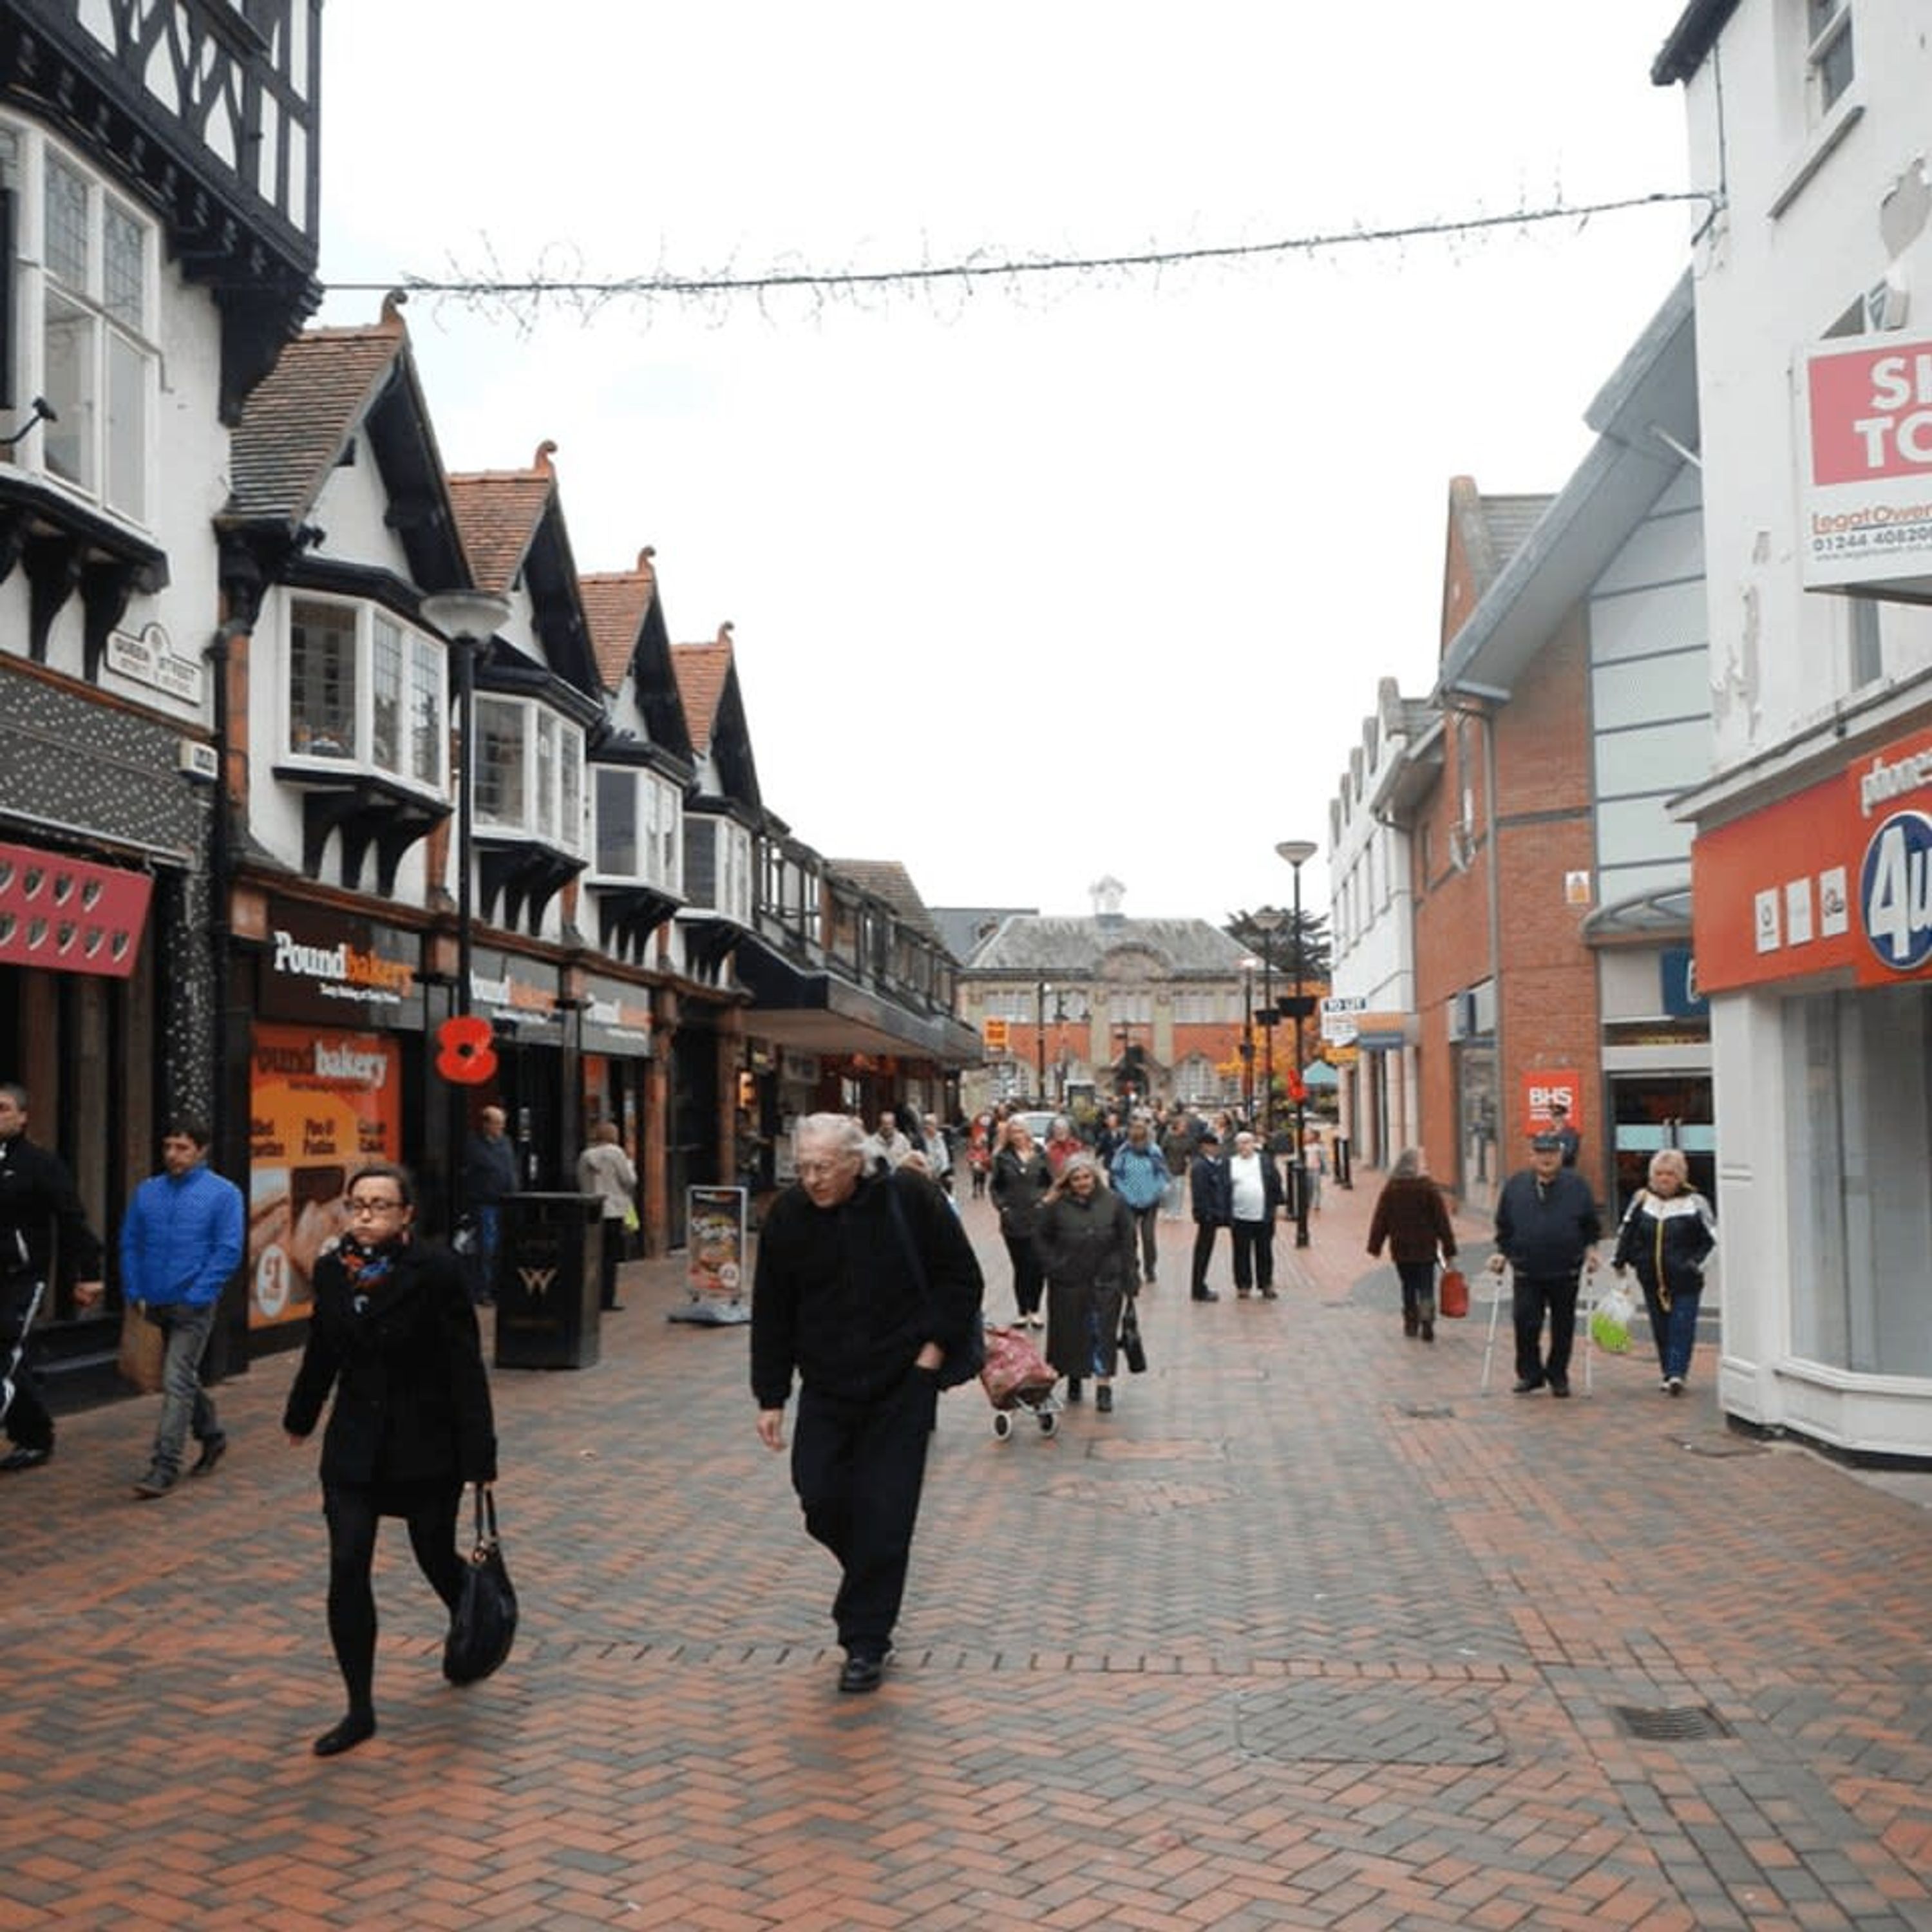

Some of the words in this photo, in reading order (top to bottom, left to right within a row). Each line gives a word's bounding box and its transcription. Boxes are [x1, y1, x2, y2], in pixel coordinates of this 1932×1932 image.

[1871, 354, 1932, 409] S
[1853, 410, 1932, 468] TO
[1861, 750, 1932, 818] phone
[1529, 1086, 1573, 1106] BHS
